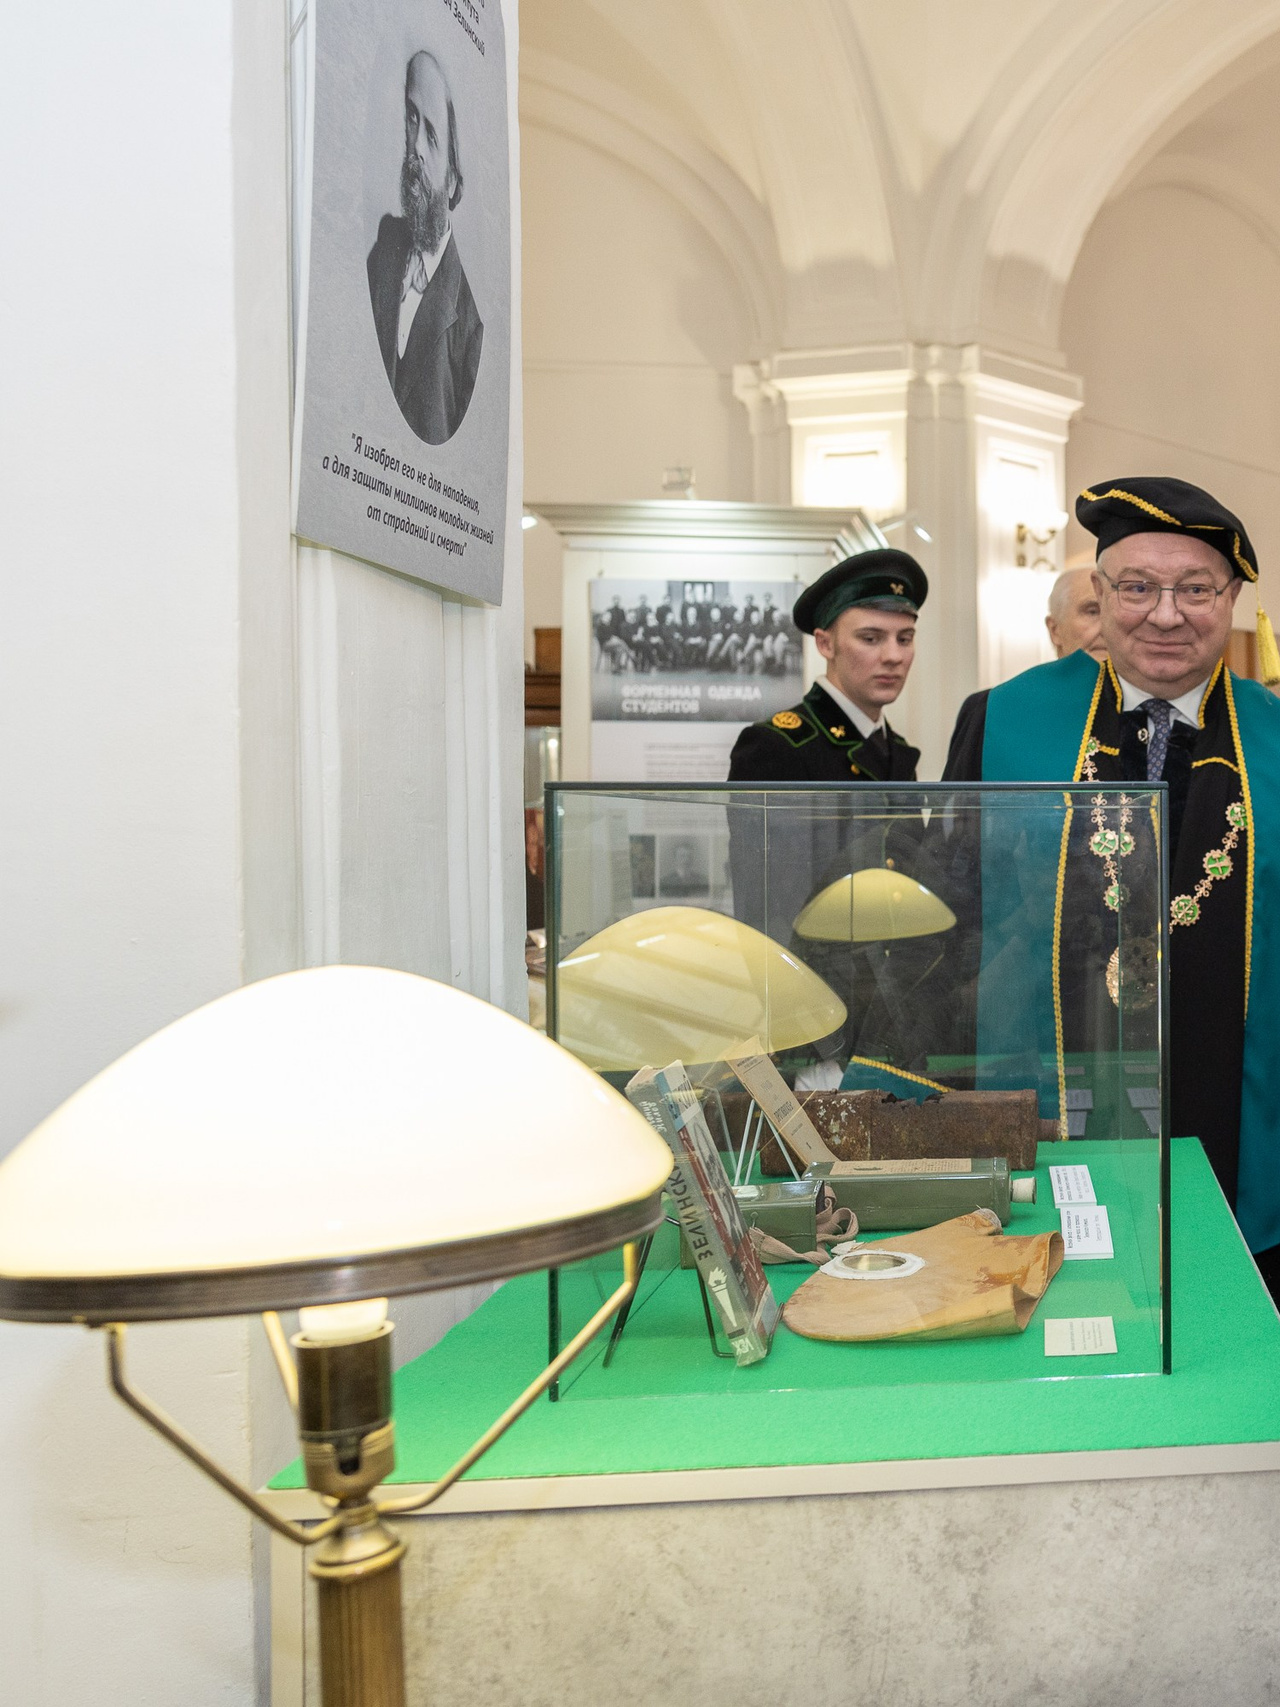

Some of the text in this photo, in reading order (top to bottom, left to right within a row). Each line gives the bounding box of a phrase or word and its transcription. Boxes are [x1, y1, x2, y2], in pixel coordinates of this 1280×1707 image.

[453, 1, 485, 57] Зелинский
[322, 455, 494, 545] а для защиты миллионов молодых жизней
[351, 433, 480, 515] "Я изобрел его не для нападения,
[366, 505, 468, 556] от страданий и смерти"
[668, 1142, 714, 1262] ЗЕЛИНСК
